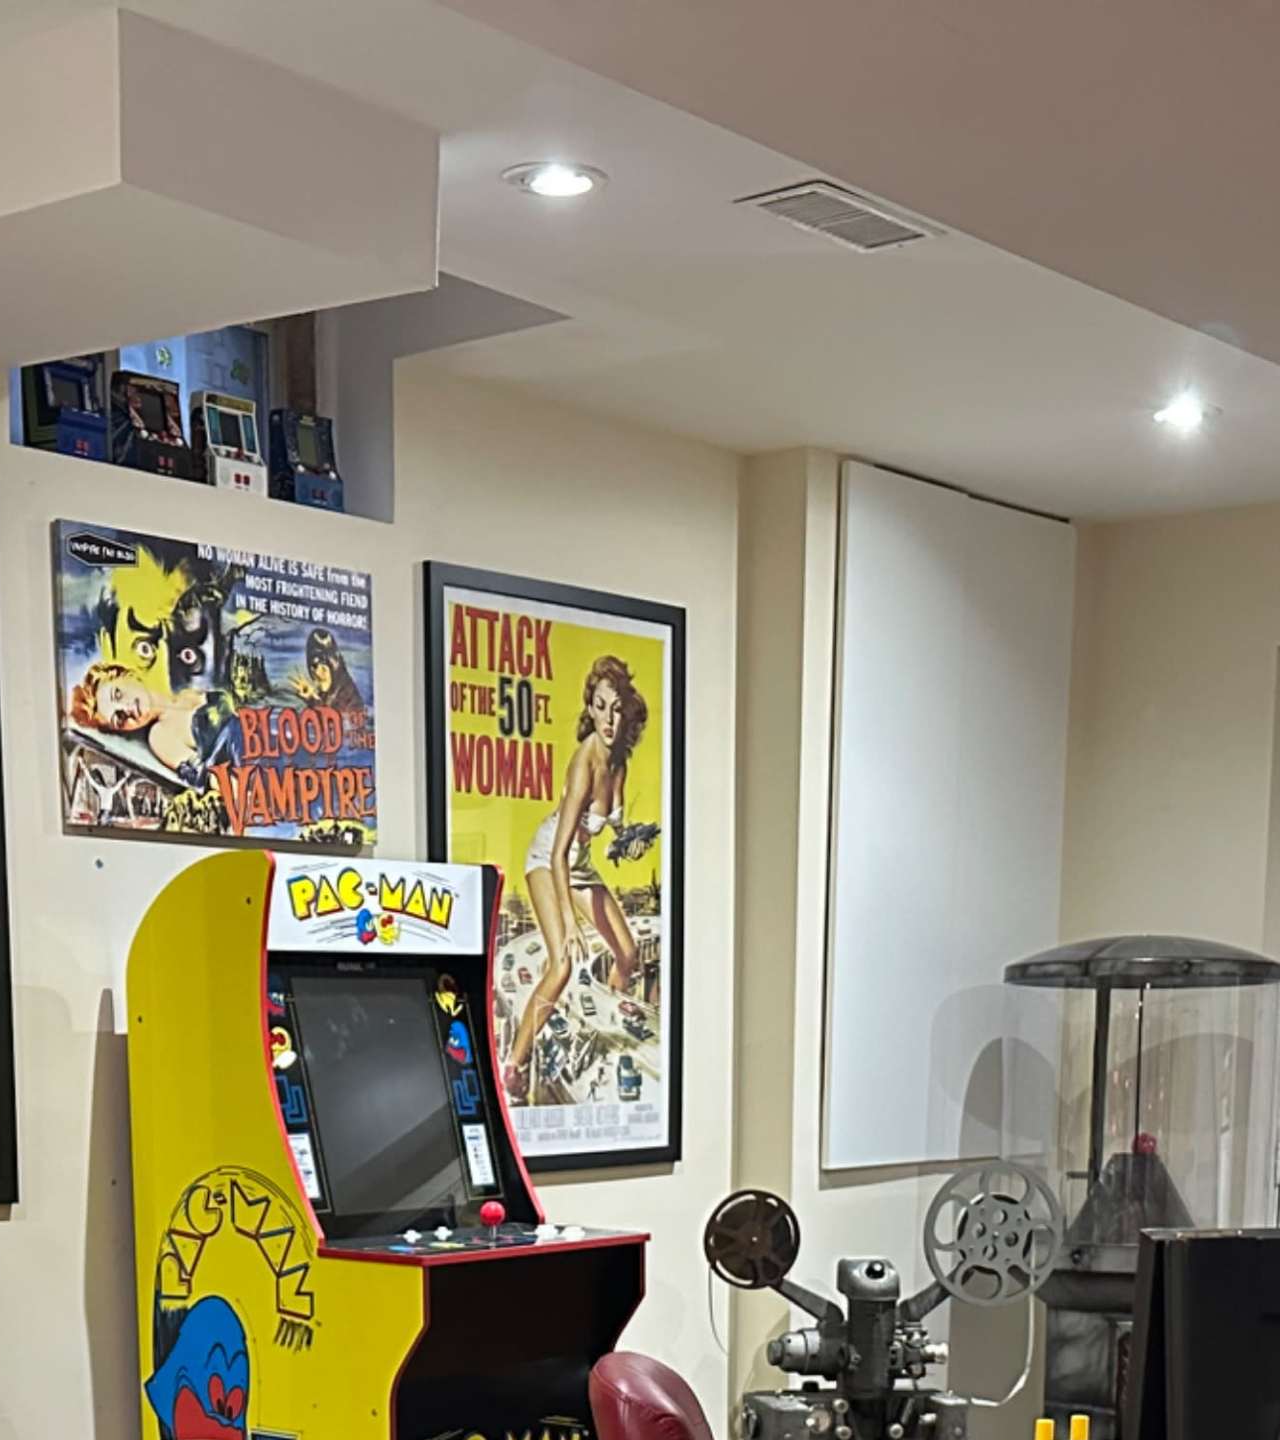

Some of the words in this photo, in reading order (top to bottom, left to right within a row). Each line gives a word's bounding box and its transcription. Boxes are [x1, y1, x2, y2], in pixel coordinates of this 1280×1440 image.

[450, 603, 553, 680] ATTACK
[238, 703, 344, 760] BLOOD
[450, 680, 467, 713] OF
[468, 684, 497, 717] THE
[498, 676, 535, 740] 50
[210, 761, 376, 836] VAMPIRE
[450, 731, 554, 802] WOMAN
[286, 867, 454, 930] PAC-MAN
